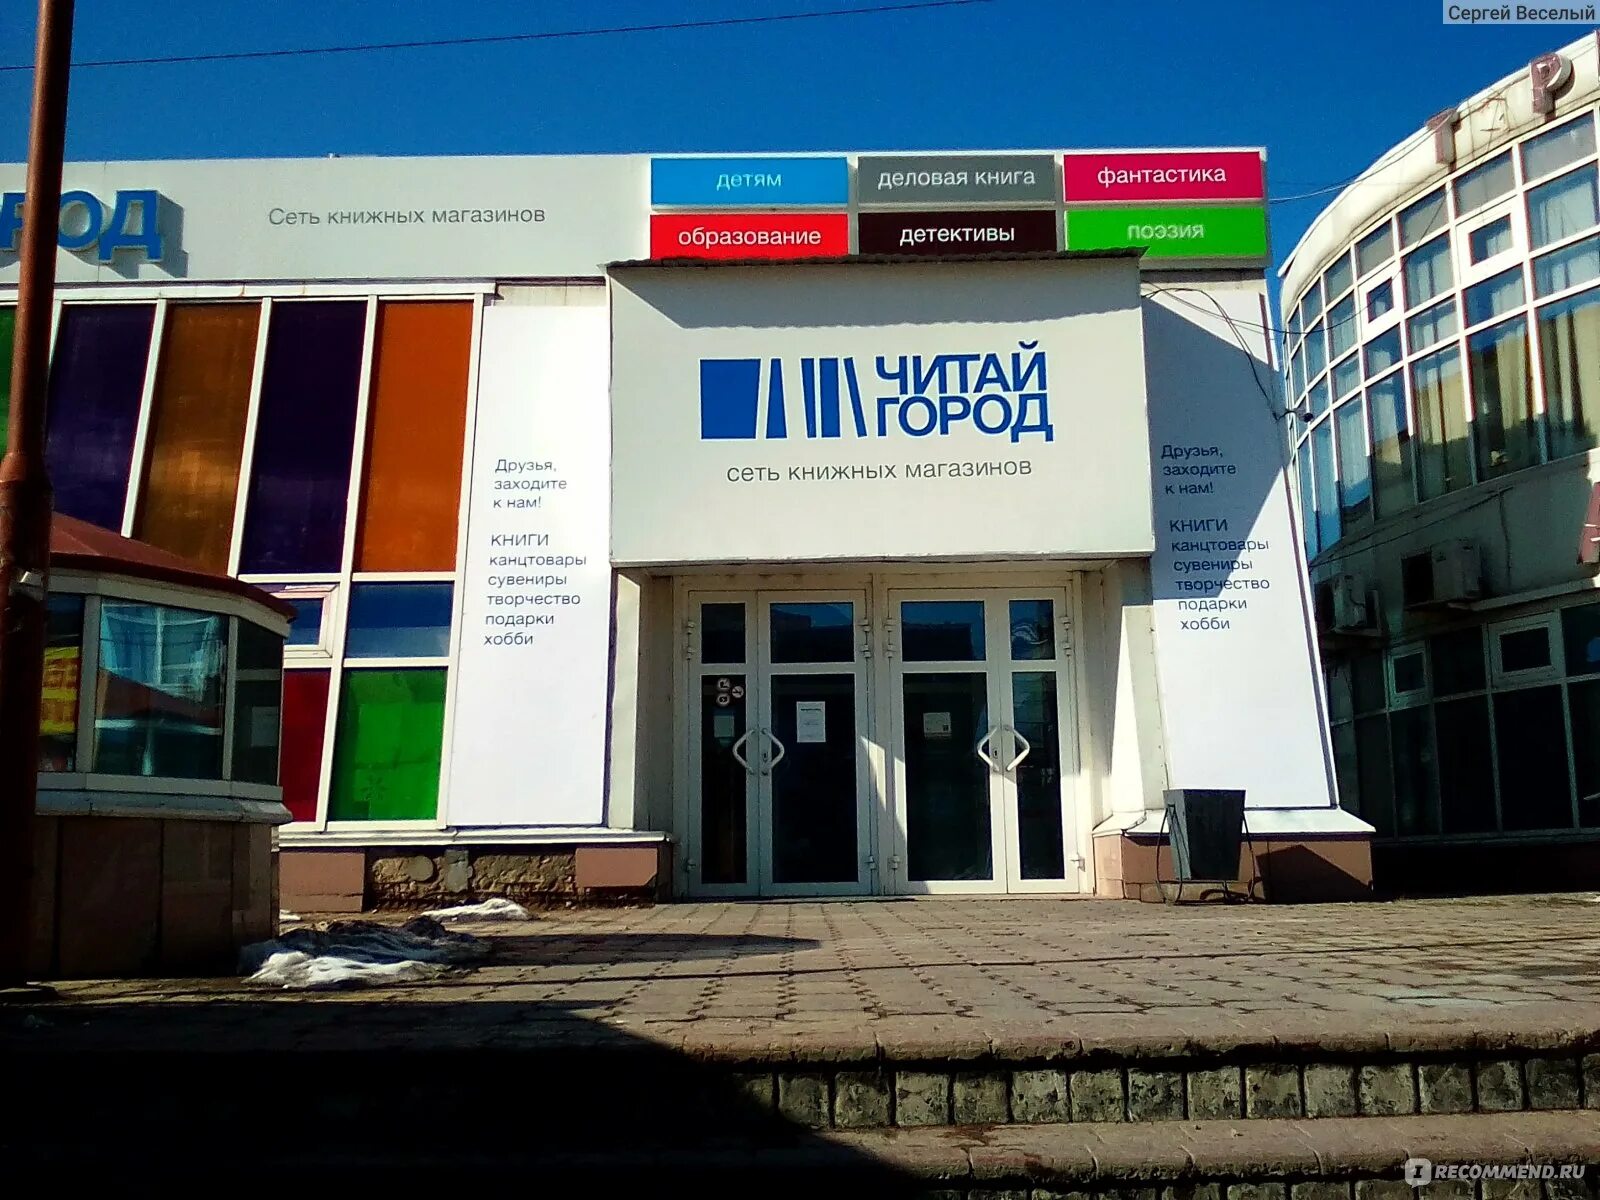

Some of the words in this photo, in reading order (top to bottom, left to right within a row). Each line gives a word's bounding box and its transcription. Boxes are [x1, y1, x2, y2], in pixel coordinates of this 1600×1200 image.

[716, 170, 783, 189] детям
[878, 169, 969, 189] деловая
[975, 169, 1036, 186] книга
[1097, 165, 1227, 188] фантастика
[268, 207, 320, 225] Сеть
[327, 208, 425, 225] книжных
[431, 207, 546, 224] магазинов
[678, 226, 822, 248] образование
[899, 224, 1016, 244] детективы
[1127, 222, 1205, 240] поэзия
[875, 340, 1047, 394] ЧИТАЙ
[876, 392, 1054, 443] ГОРОД
[1161, 445, 1223, 459] Друзья,
[495, 459, 557, 473] Друзья,
[727, 464, 779, 482] сеть
[788, 463, 896, 481] книжных
[906, 459, 1032, 477] магазинов
[1163, 463, 1236, 477] заходите
[494, 479, 567, 491] заходите
[1165, 485, 1174, 494] к
[1179, 482, 1214, 494] нам!
[493, 498, 501, 508] к
[507, 497, 541, 508] нам!
[1172, 539, 1269, 552] канцтовары
[490, 555, 587, 567] канцтовары
[1174, 559, 1253, 573] сувениры
[488, 575, 567, 588] сувениры
[1175, 578, 1270, 593] творчество
[487, 594, 581, 607] творчество
[1178, 598, 1247, 611] подарки
[485, 614, 554, 626] подарки
[1181, 617, 1230, 630] хобби
[484, 631, 534, 645] хобби
